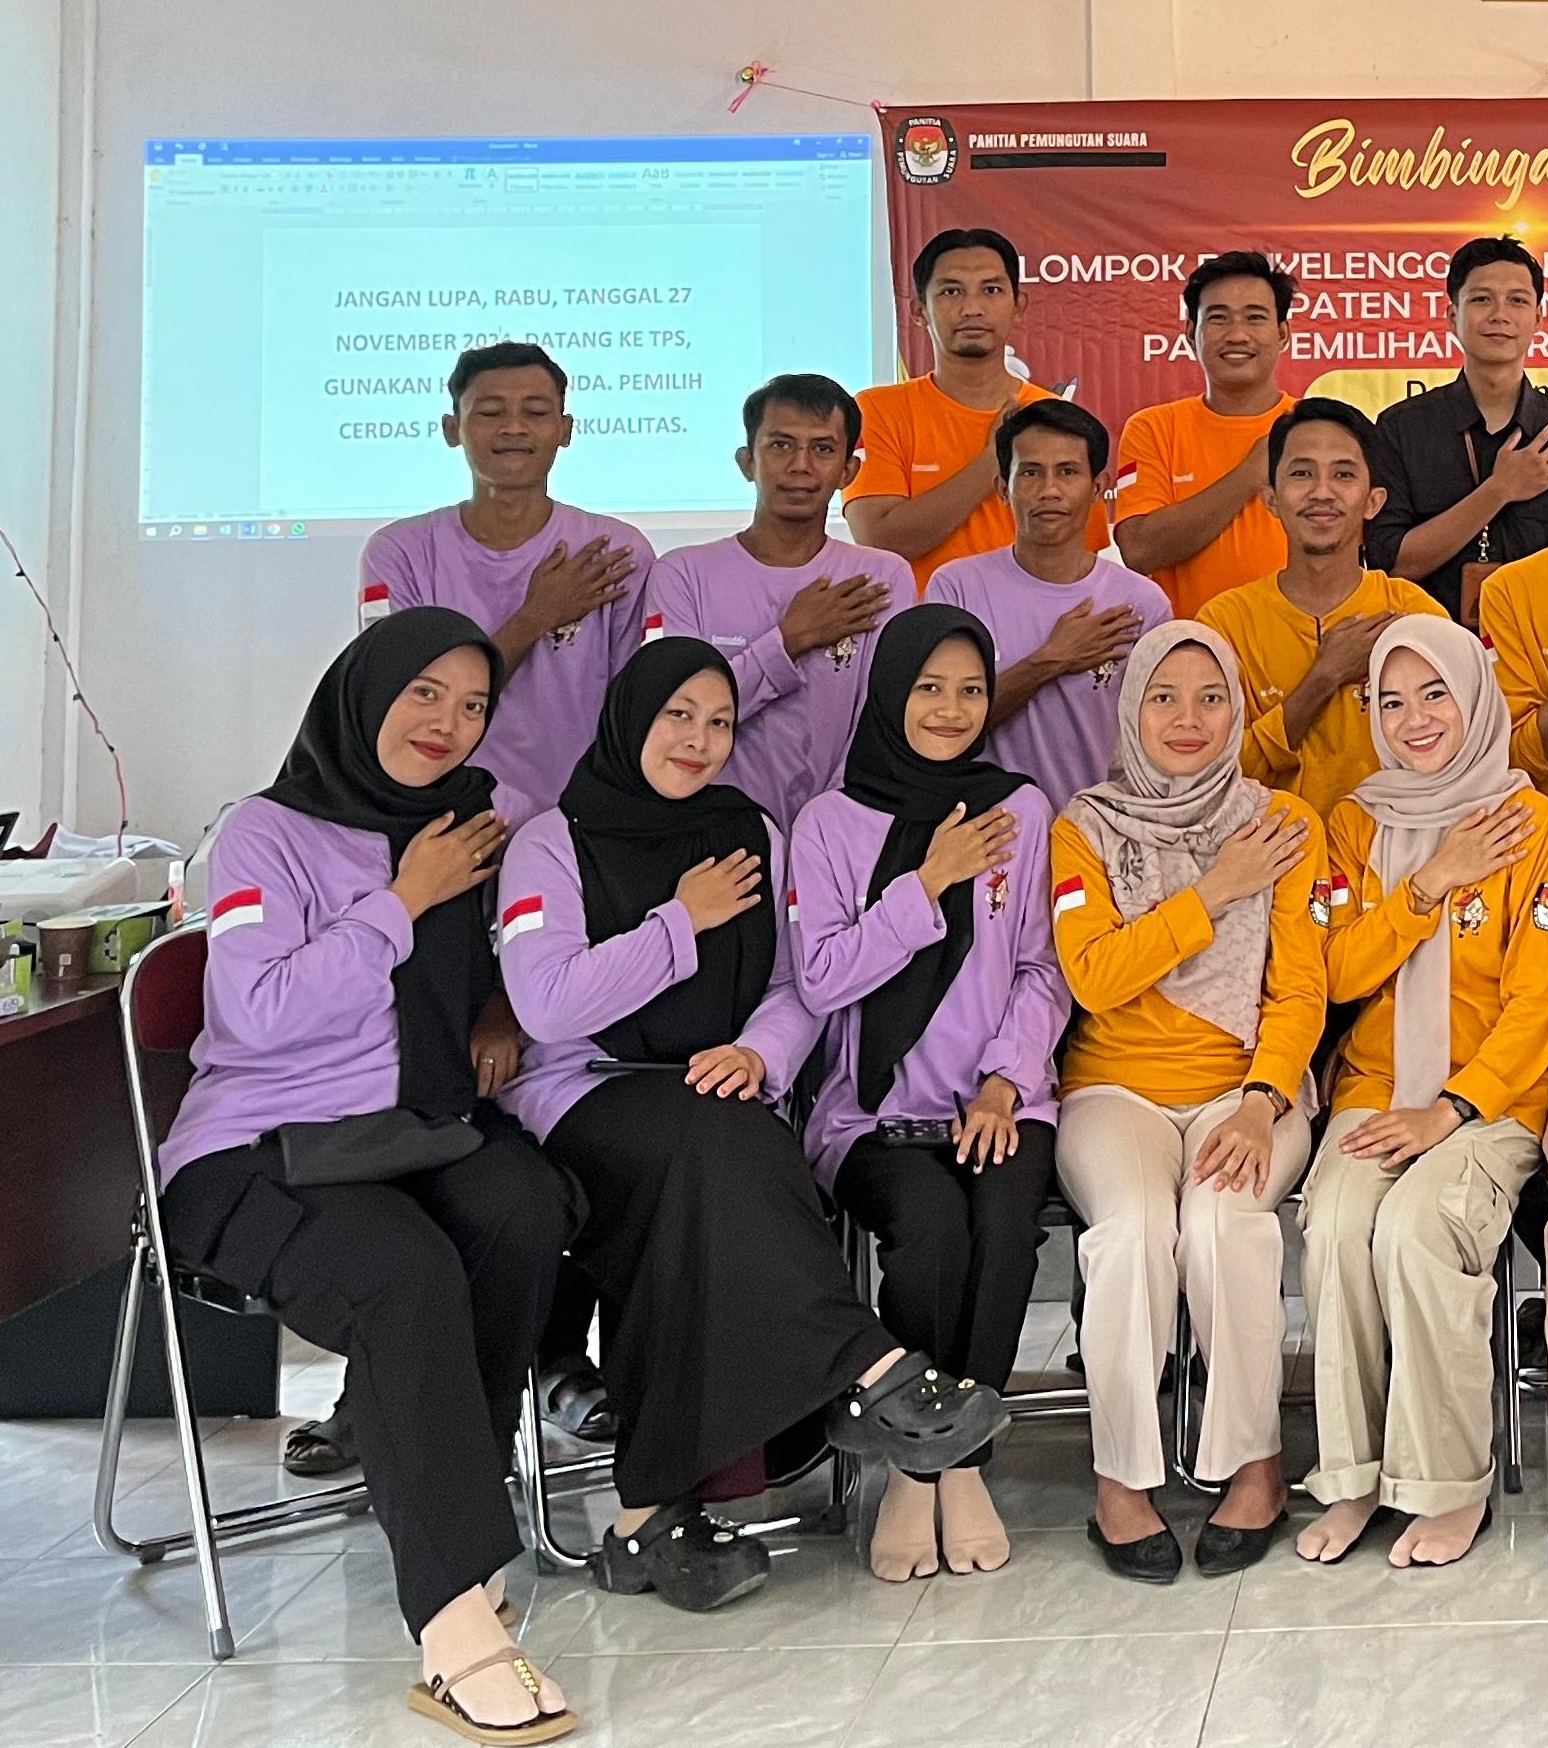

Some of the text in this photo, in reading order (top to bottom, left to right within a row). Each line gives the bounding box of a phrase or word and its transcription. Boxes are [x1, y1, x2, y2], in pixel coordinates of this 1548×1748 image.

[968, 132, 1148, 149] PANITIA PEMUNGUTAN SUARA
[1018, 253, 1187, 283] LOMPOK
[1198, 251, 1450, 281] YELENGG
[334, 286, 692, 309] JANGAN LUPA, RABU, TANGGAL 27
[336, 332, 457, 353] NOVEMBER
[525, 331, 612, 349] DATANG
[619, 331, 644, 348] KE
[649, 330, 691, 350] TPS,
[1142, 333, 1197, 362] PA
[1281, 332, 1466, 360] EMILIHAN
[324, 376, 432, 396] GUNAKAN
[619, 372, 702, 392] PEMILIH
[339, 421, 421, 440] CERDAS
[573, 417, 688, 436] RKUALITAS.
